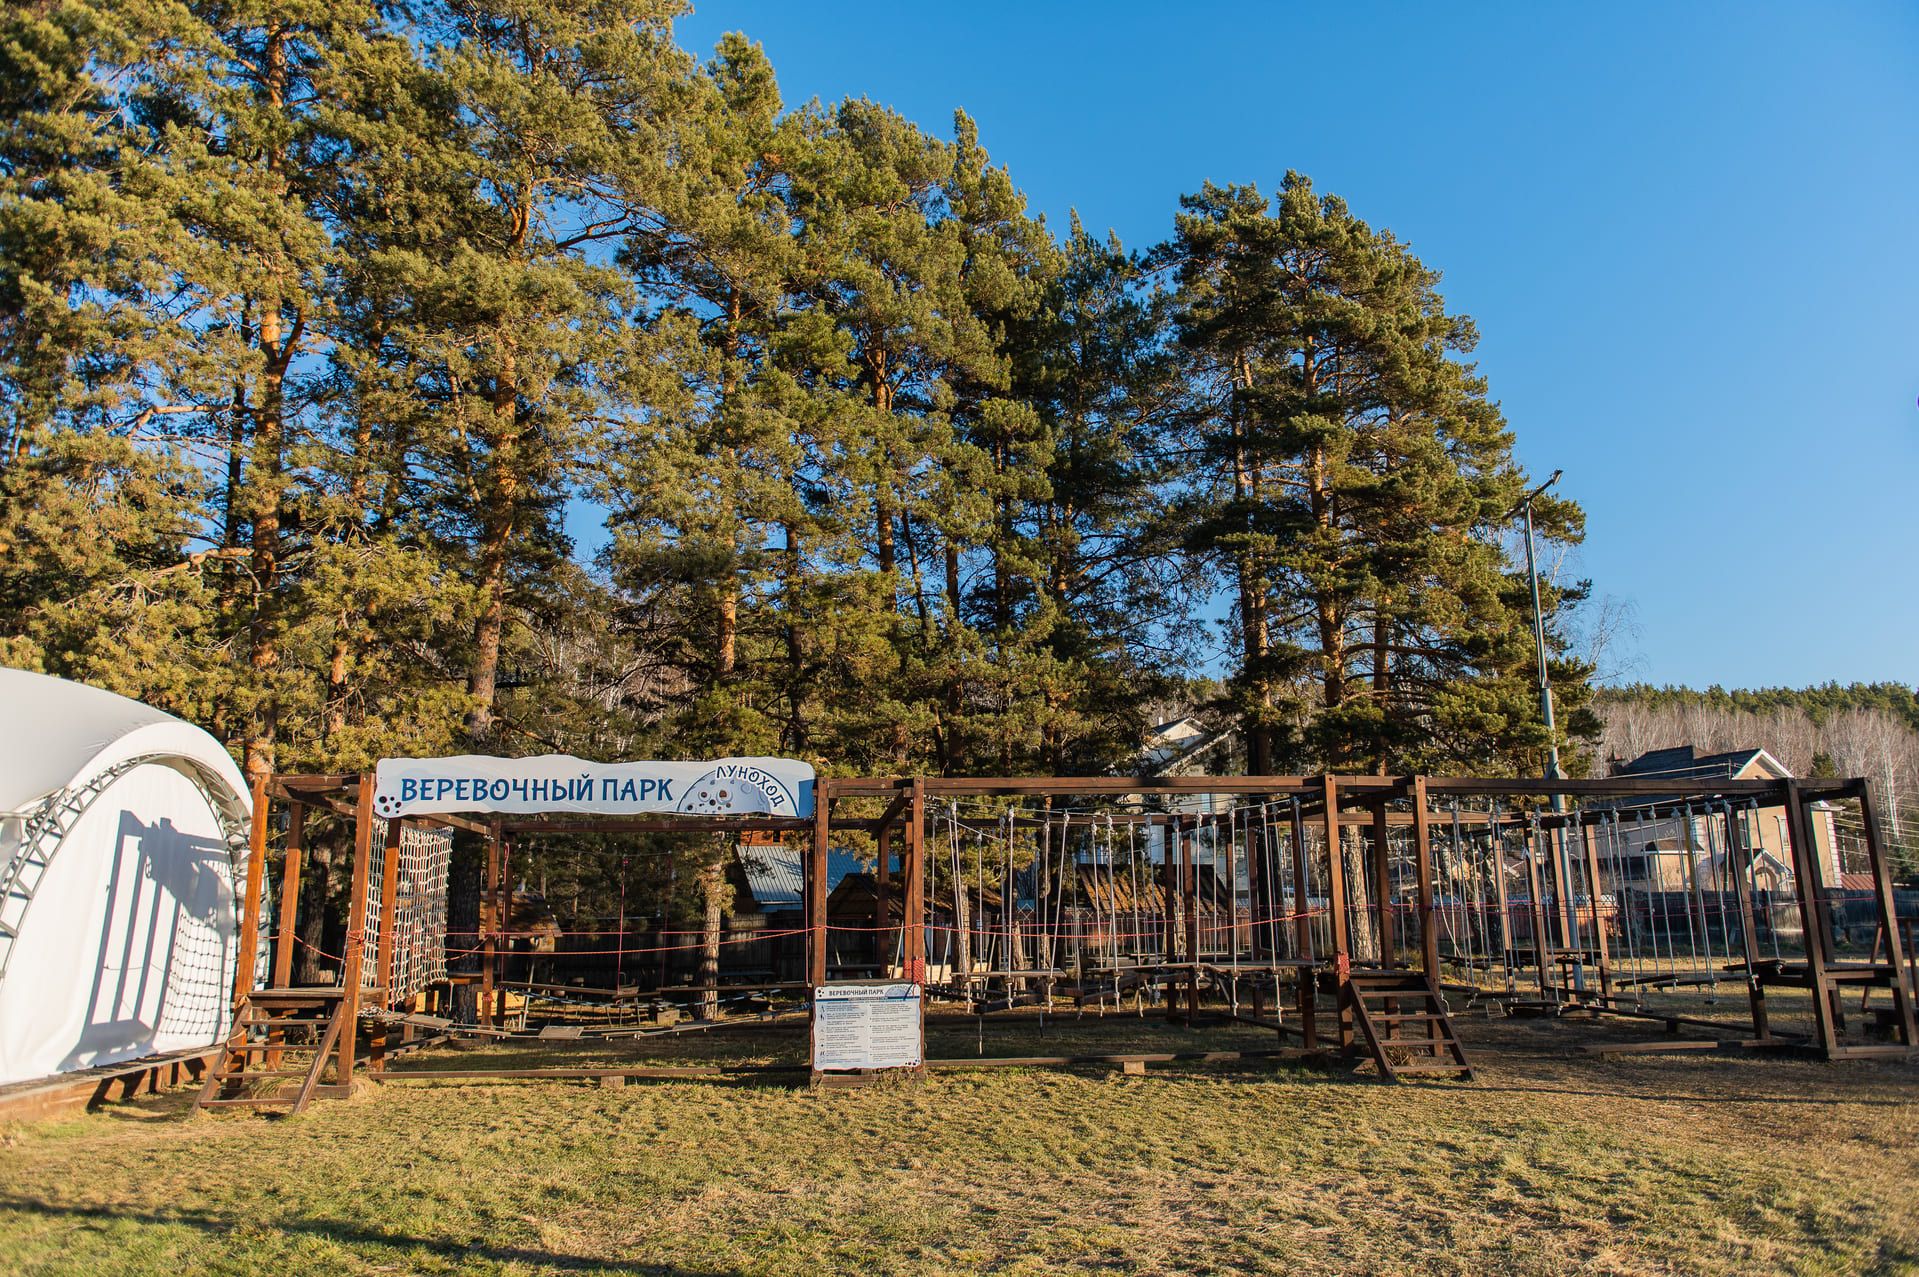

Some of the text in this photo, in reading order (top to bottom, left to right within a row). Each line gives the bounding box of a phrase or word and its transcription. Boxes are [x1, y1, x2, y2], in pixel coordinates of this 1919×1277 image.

[401, 773, 674, 802] ВЕРЕВОЧНЫЙ ПАРК
[716, 765, 785, 808] ЛУНОХОД
